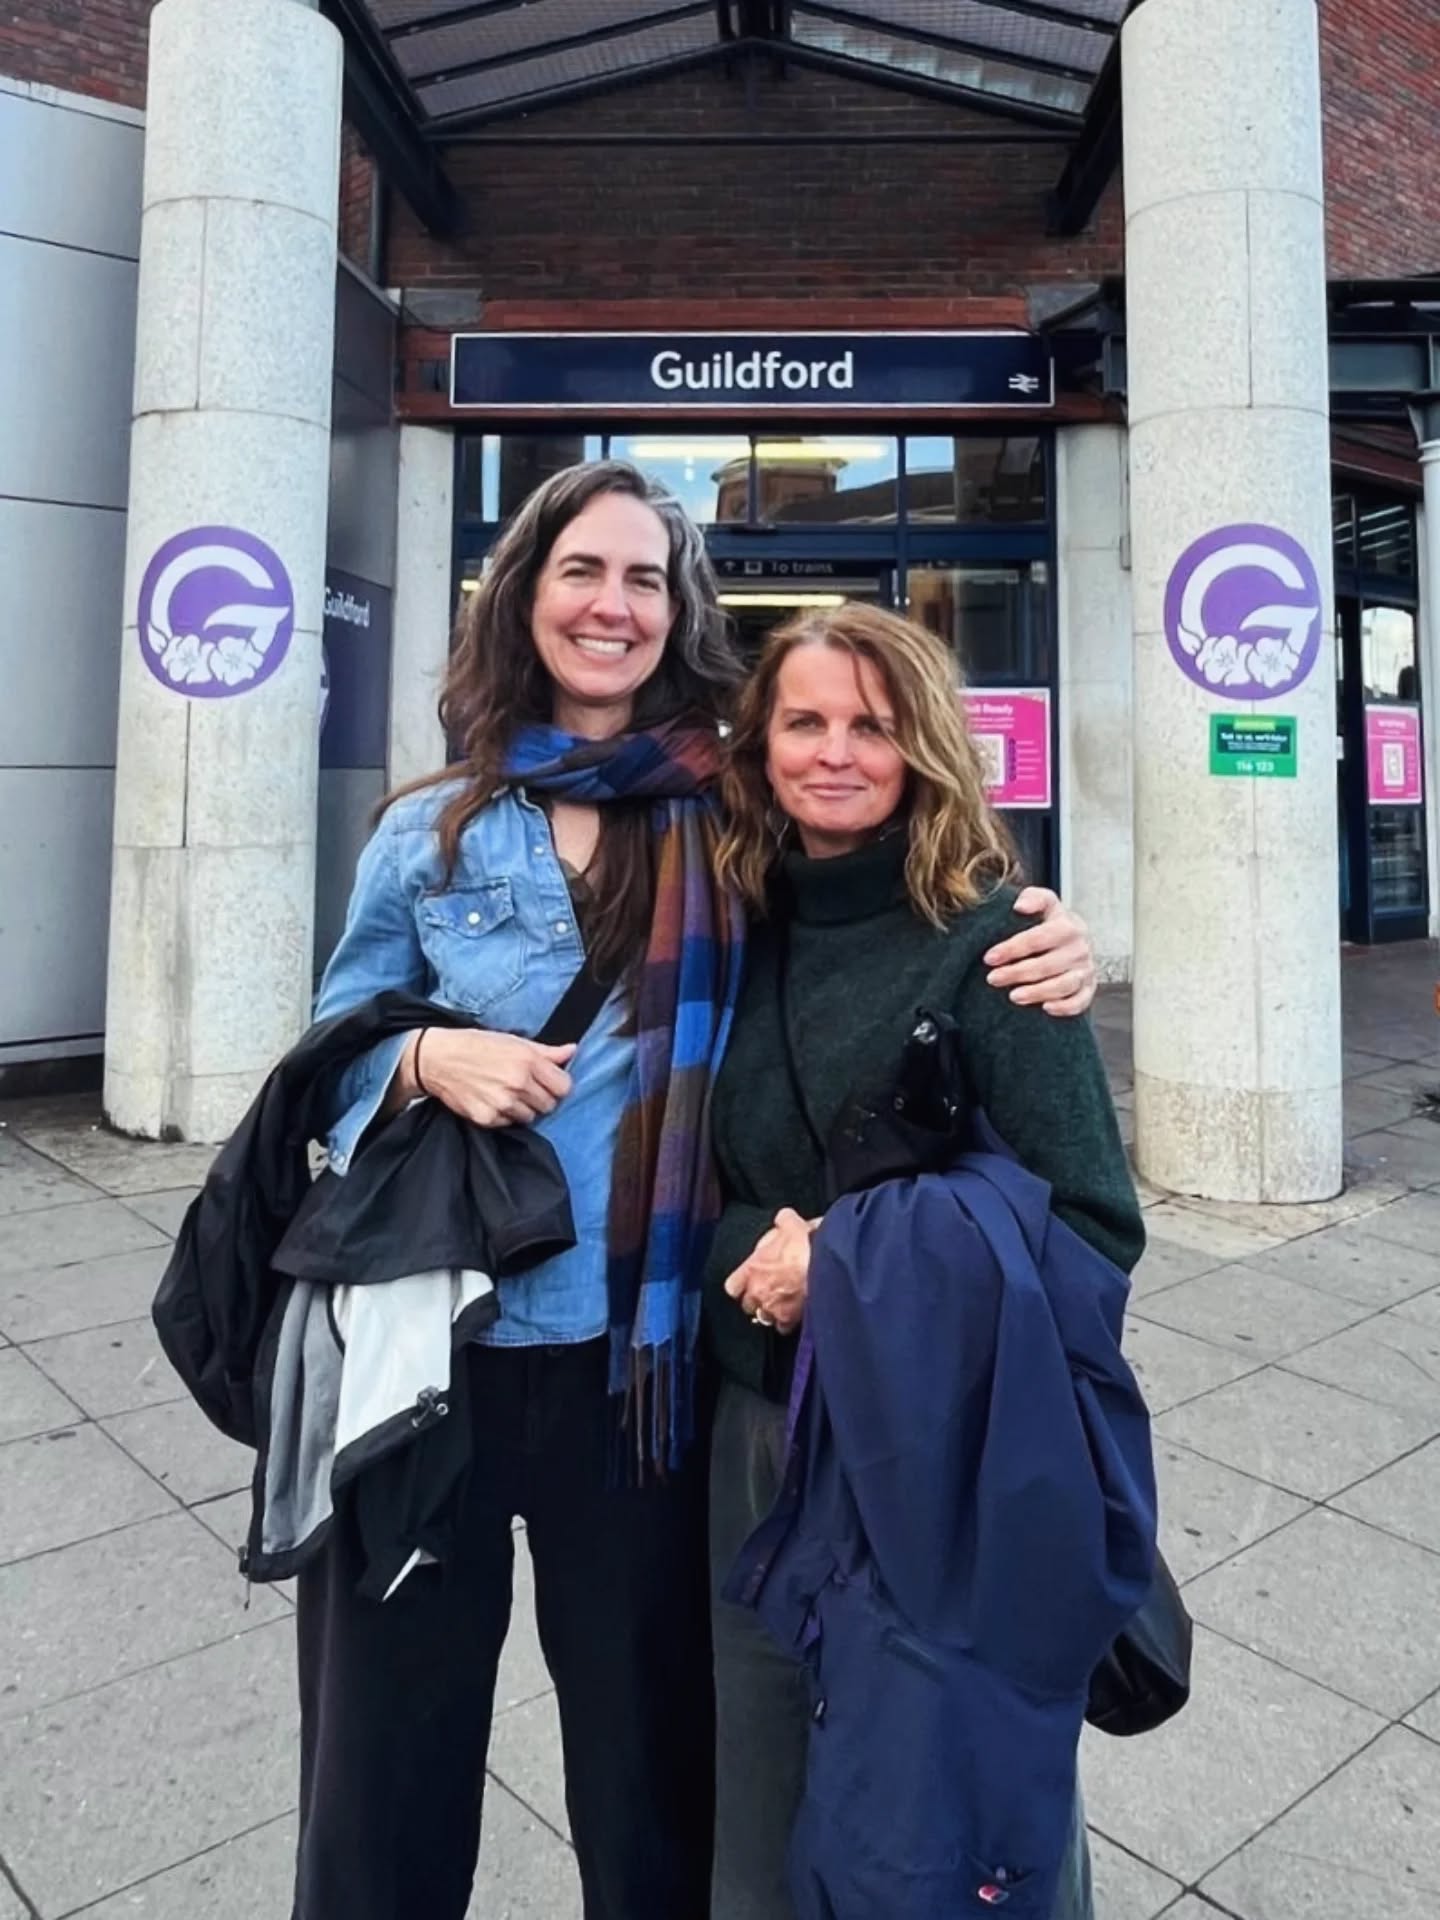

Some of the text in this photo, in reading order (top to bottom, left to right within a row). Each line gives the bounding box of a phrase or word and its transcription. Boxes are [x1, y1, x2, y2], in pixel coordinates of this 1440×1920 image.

[651, 350, 853, 389] Guildford
[771, 560, 834, 574] To trains
